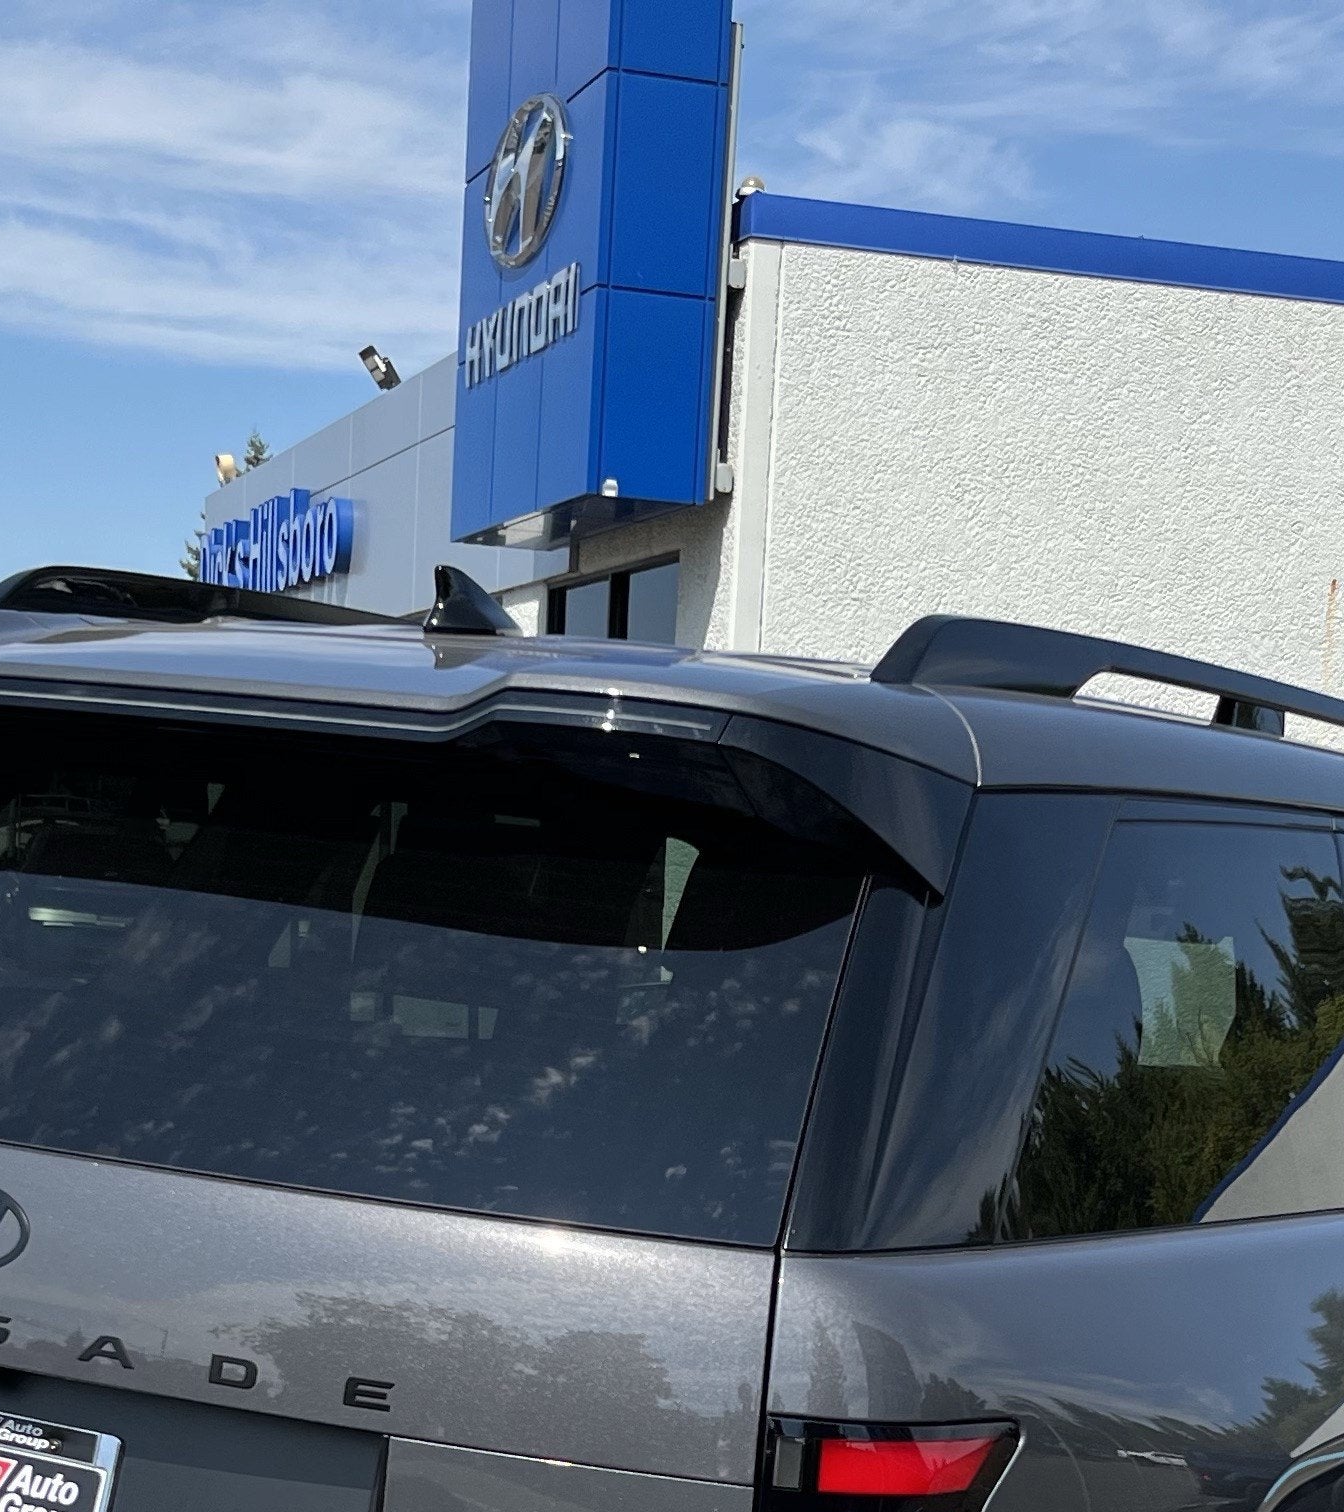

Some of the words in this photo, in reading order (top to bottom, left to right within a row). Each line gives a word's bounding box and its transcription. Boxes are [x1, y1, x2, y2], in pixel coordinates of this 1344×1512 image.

[465, 262, 580, 389] HYUNDAI
[249, 488, 342, 593] Hillsboro
[3, 1419, 43, 1437] Auto
[6, 1464, 80, 1505] Auto
